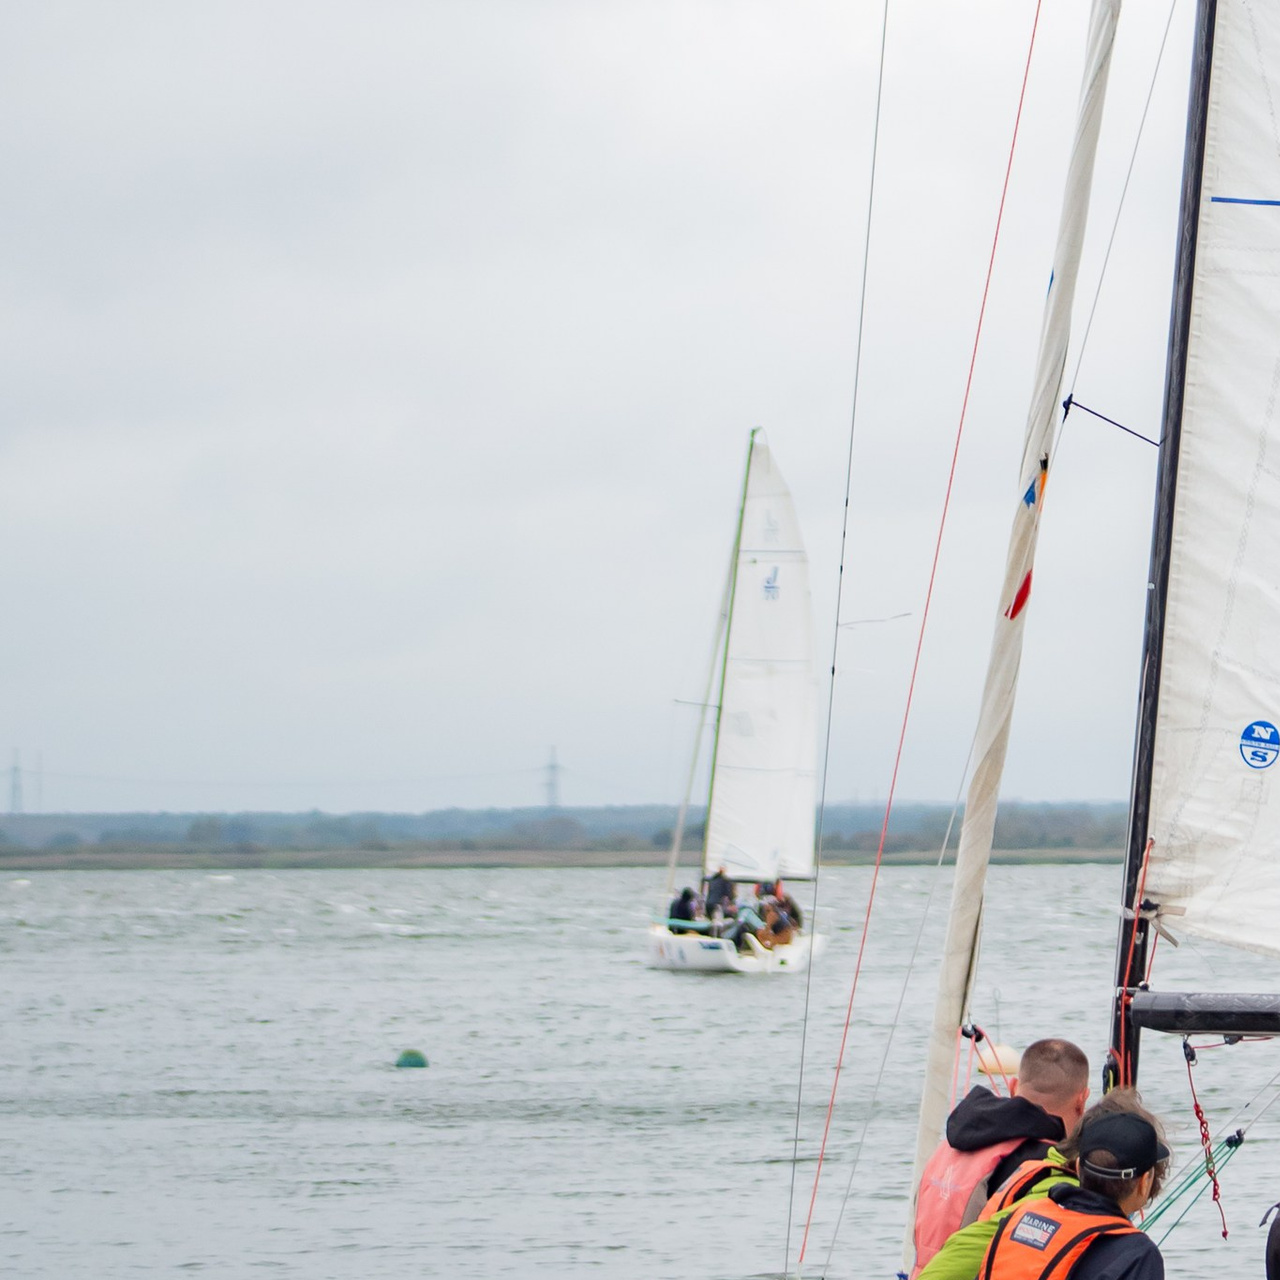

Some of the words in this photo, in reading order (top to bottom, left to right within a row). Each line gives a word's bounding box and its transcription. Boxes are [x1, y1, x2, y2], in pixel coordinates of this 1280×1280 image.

[1251, 724, 1275, 740] N
[1250, 750, 1268, 762] S
[1021, 1215, 1055, 1233] MARINE
